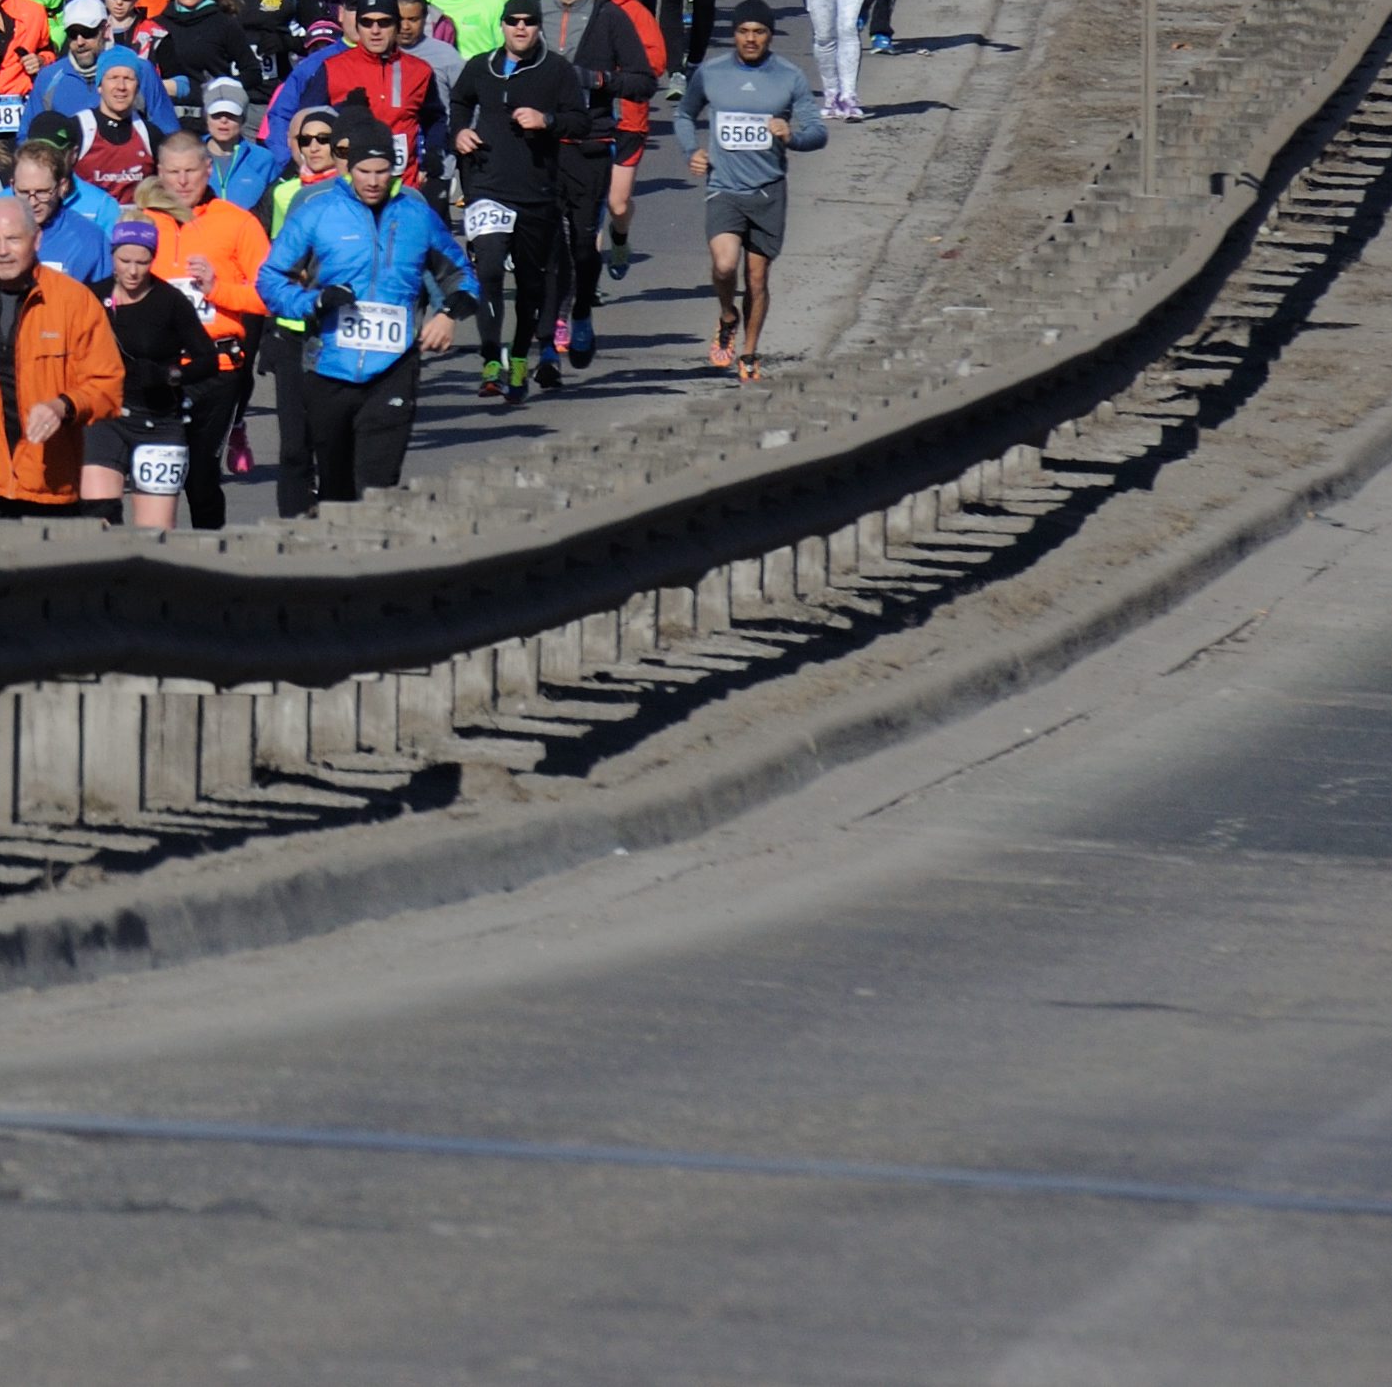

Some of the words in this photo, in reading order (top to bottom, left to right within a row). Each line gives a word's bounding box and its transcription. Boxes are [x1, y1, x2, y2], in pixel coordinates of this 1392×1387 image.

[720, 125, 768, 143] 6568
[94, 171, 143, 183] Longboat
[468, 210, 511, 233] 3256
[342, 316, 401, 343] 3610
